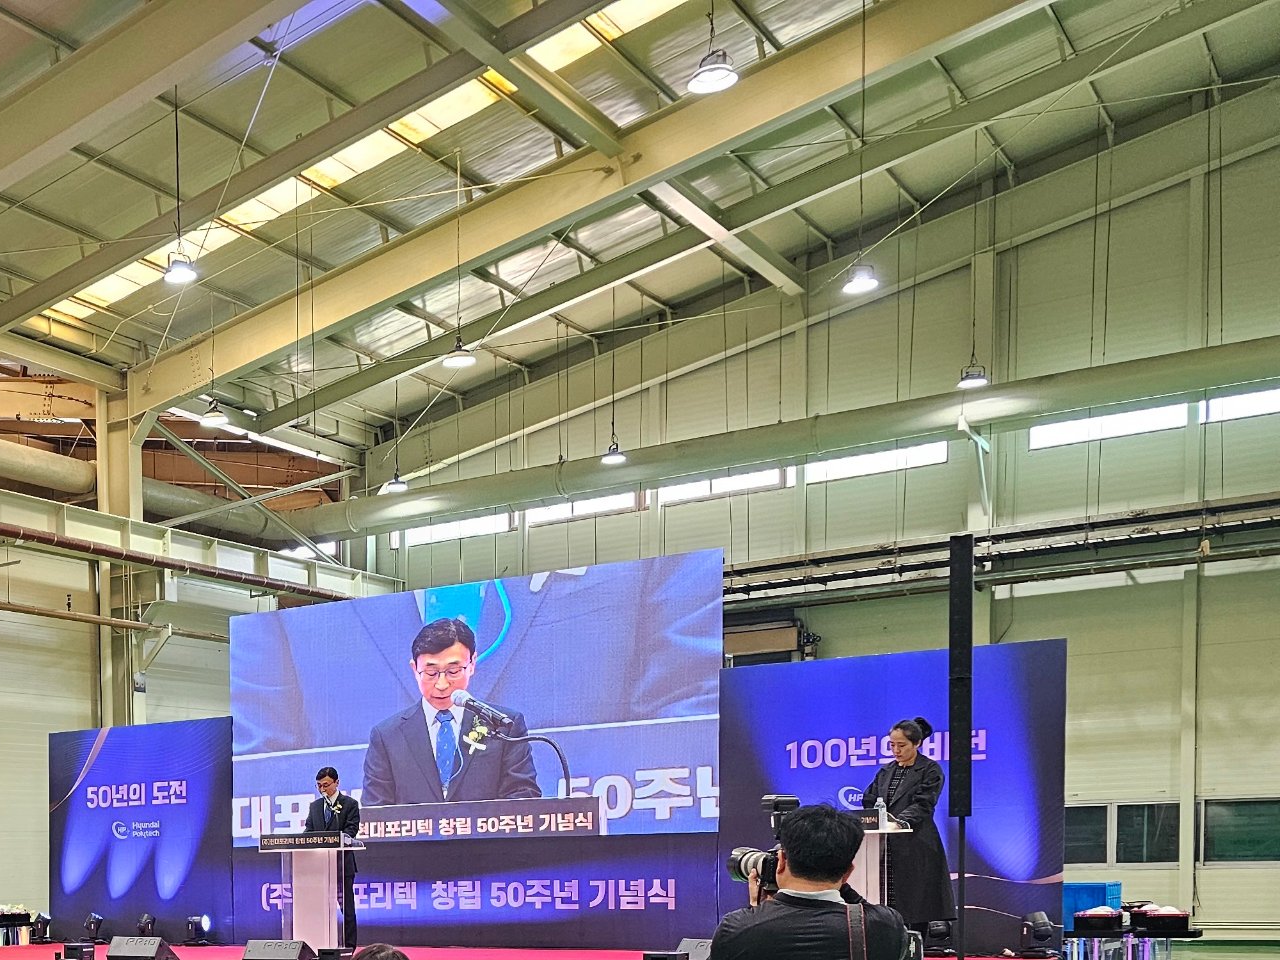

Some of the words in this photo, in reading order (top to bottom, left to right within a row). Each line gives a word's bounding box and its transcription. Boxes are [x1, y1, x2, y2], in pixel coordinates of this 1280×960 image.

[86, 782, 146, 809] 50년의
[151, 780, 187, 805] 도전
[133, 821, 160, 830] Hyundai
[133, 830, 160, 838] Polytech
[438, 816, 471, 835] 창립
[476, 815, 534, 833] 50주년
[539, 812, 593, 831] 기념식
[431, 880, 481, 910] 창립
[490, 879, 579, 909] 50주년
[589, 879, 676, 910] 기념식
